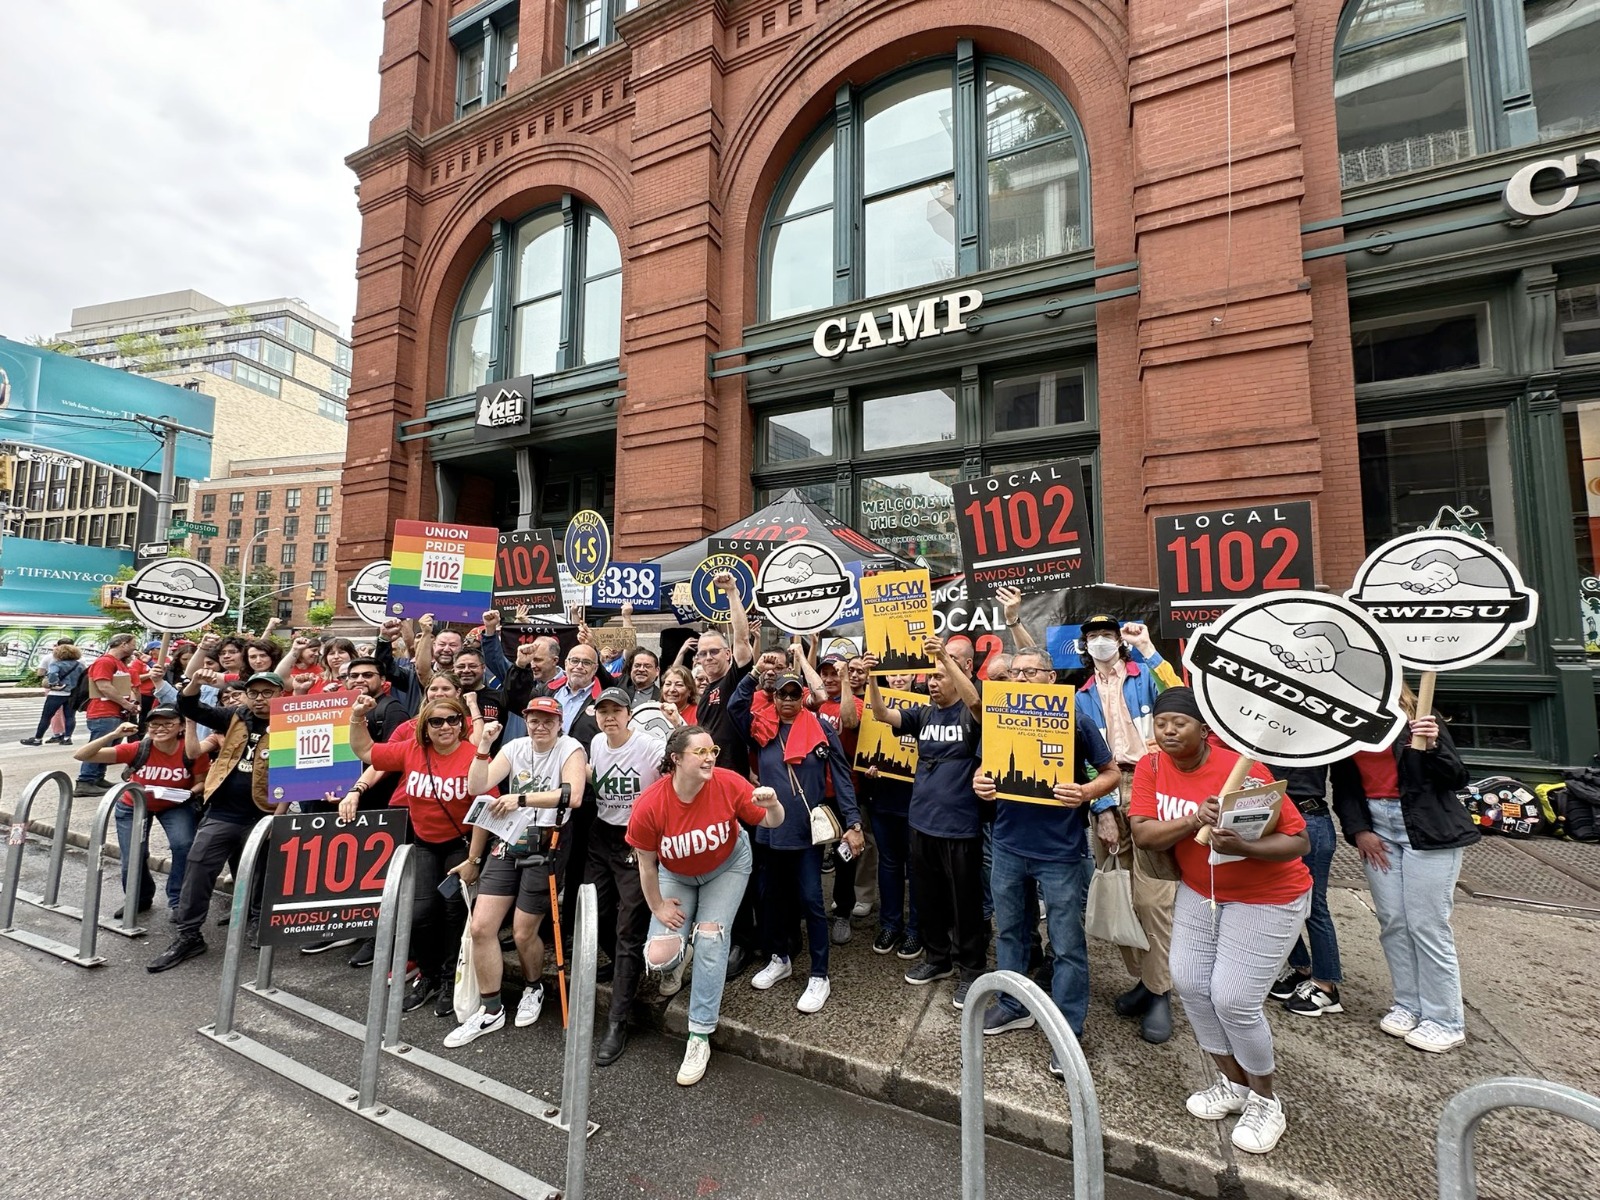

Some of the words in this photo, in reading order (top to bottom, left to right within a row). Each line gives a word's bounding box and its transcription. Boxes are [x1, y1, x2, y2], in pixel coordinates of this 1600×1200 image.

[813, 289, 983, 357] CAMP
[492, 398, 522, 419] REI
[30, 452, 76, 465] SKYLINE
[969, 467, 1061, 495] LOCAL
[862, 496, 936, 514] WELCOME
[574, 513, 600, 527] RWDSU
[744, 516, 808, 528] LOCAL
[869, 516, 897, 530] THE
[901, 511, 950, 527] CO-OP
[965, 485, 1078, 555] 1102
[1174, 508, 1287, 530] LOCAL
[425, 527, 468, 539] UNION
[579, 525, 593, 533] LOCAL
[499, 532, 542, 544] OCAL
[718, 541, 777, 551] LOCAL
[426, 541, 465, 553] PRIDE
[574, 537, 597, 563] 1-S
[701, 556, 738, 573] RWDSU
[1167, 527, 1300, 593] 1102
[426, 561, 460, 580] 1102
[576, 571, 594, 583] UFCW
[974, 566, 1026, 582] RWDSU
[1036, 558, 1082, 574] UFCW
[597, 573, 607, 604] LOCA
[605, 566, 655, 599] 338
[877, 579, 924, 597] UFCW
[987, 579, 1024, 589] ORGANIZE
[1026, 576, 1041, 584] FOR
[1044, 572, 1070, 581] POWER
[136, 592, 215, 609] RWDSU
[357, 594, 387, 602] RWD
[531, 594, 556, 604] UFCW
[767, 585, 842, 604] RWDSU
[790, 608, 820, 617] UFCW
[840, 608, 859, 618] FCW
[873, 602, 899, 613] Local
[901, 599, 928, 611] 1500
[1366, 605, 1510, 618] RWDSU
[711, 611, 731, 621] UFC
[933, 606, 1006, 634] OCAL
[1171, 610, 1224, 621] RWDS
[1208, 655, 1368, 728] RWDSU
[283, 697, 348, 712] CELEBRATING
[1006, 693, 1067, 712] UFCW
[286, 710, 344, 723] SOLIDARITY
[998, 714, 1031, 727] Local
[1035, 717, 1069, 730] 1500
[1239, 706, 1296, 736] UFCW
[299, 734, 331, 756] 1102
[136, 766, 191, 782] RWDSU
[406, 770, 468, 801] RWDSU
[605, 777, 641, 794] REI
[291, 814, 388, 830] LOCAL
[661, 820, 731, 859] RWDSU
[280, 831, 395, 896] 1102
[270, 911, 330, 926] RWDSU
[284, 924, 325, 933] ORGANIZE
[327, 922, 344, 931] FOR
[345, 920, 374, 929] POWER
